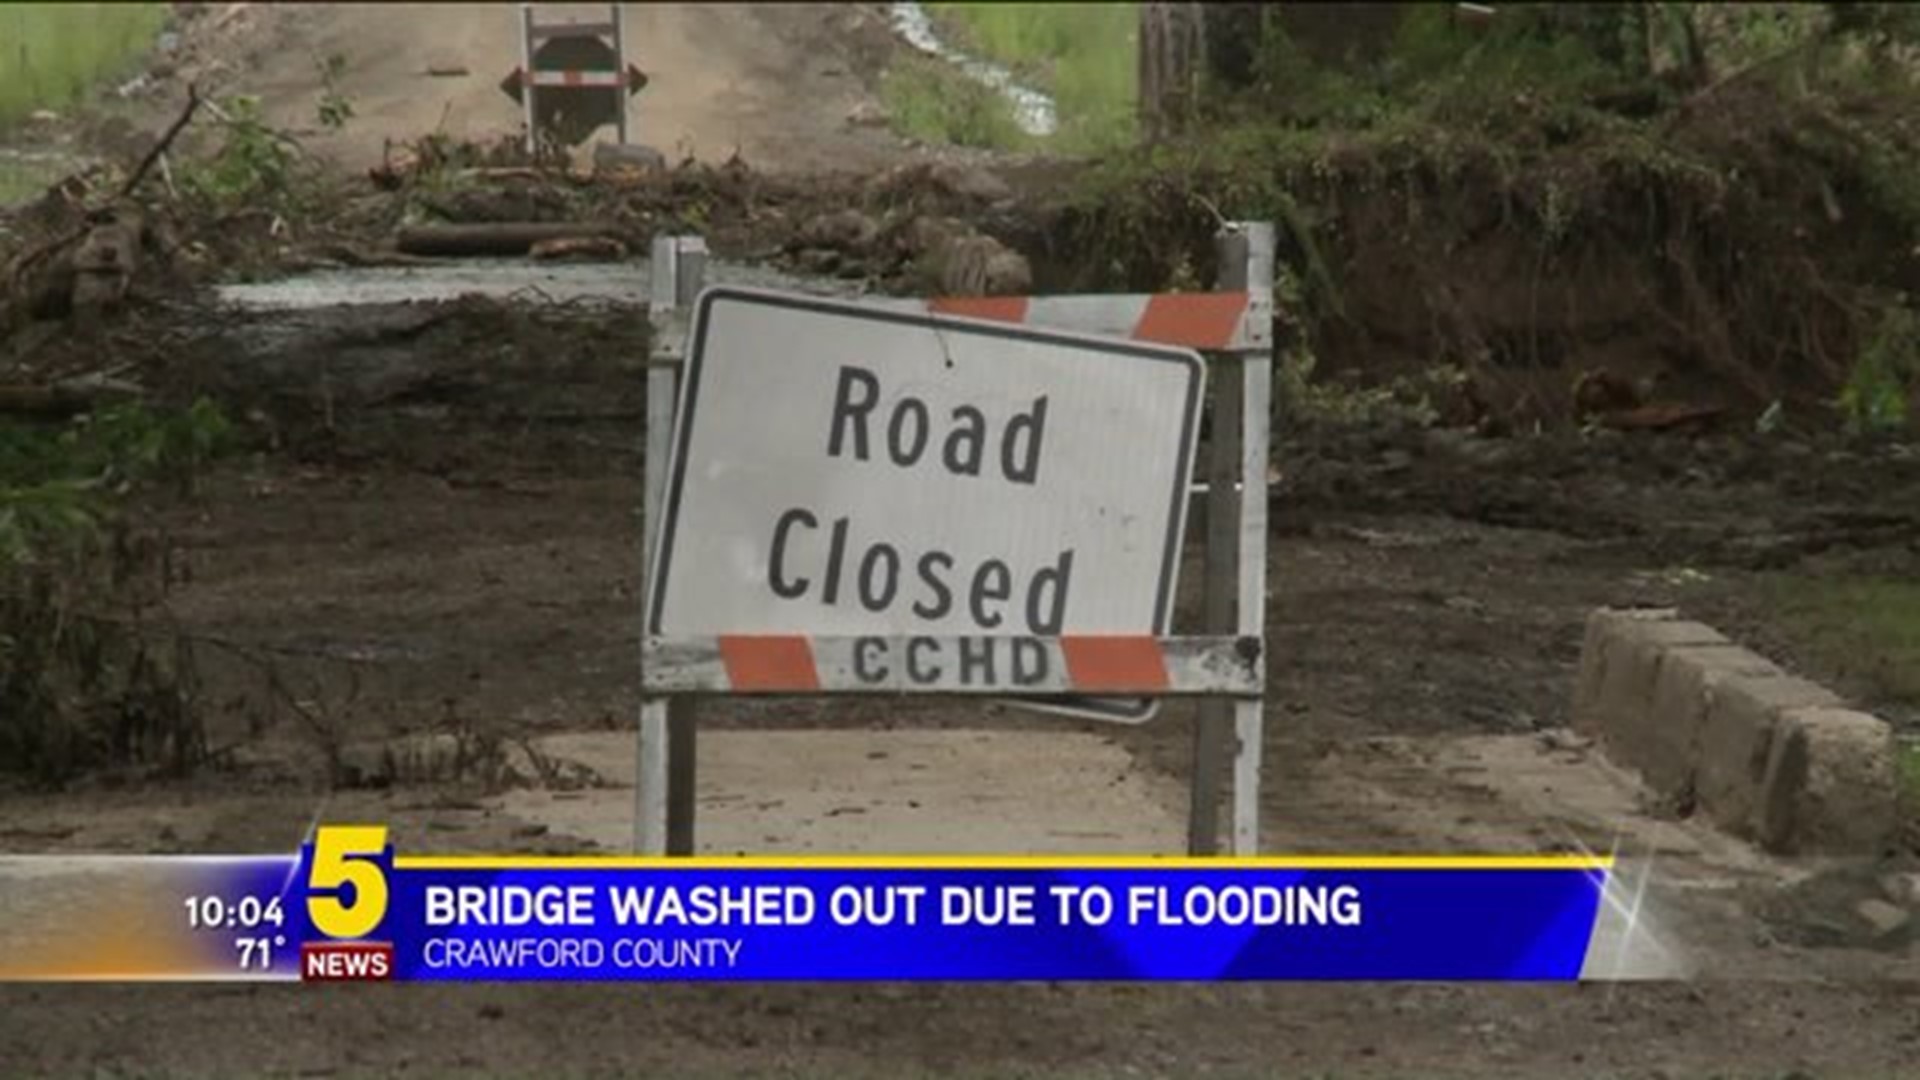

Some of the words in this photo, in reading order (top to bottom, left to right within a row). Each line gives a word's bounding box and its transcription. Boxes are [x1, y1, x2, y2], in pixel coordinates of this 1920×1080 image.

[827, 365, 1048, 485] Road
[766, 507, 1074, 636] Closed
[853, 636, 1049, 686] CCHD
